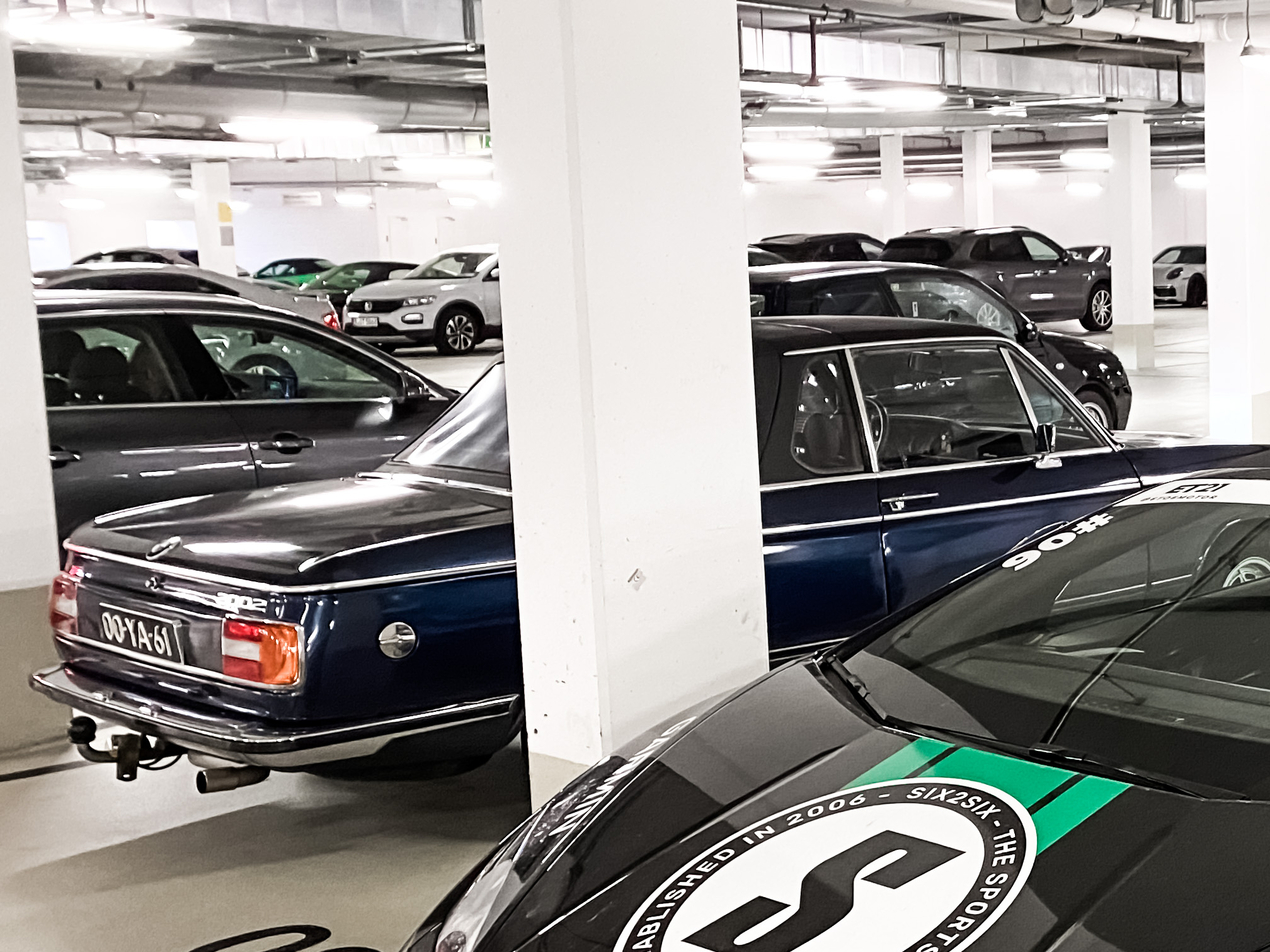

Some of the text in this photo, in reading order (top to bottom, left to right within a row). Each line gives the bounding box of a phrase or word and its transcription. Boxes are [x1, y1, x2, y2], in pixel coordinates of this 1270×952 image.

[1165, 483, 1231, 494] ET21
[100, 610, 174, 658] 00-YA-61
[742, 825, 776, 845] IN
[785, 792, 867, 828] 2006
[906, 786, 1002, 821] SIX2SIX
[991, 828, 1018, 868] THE
